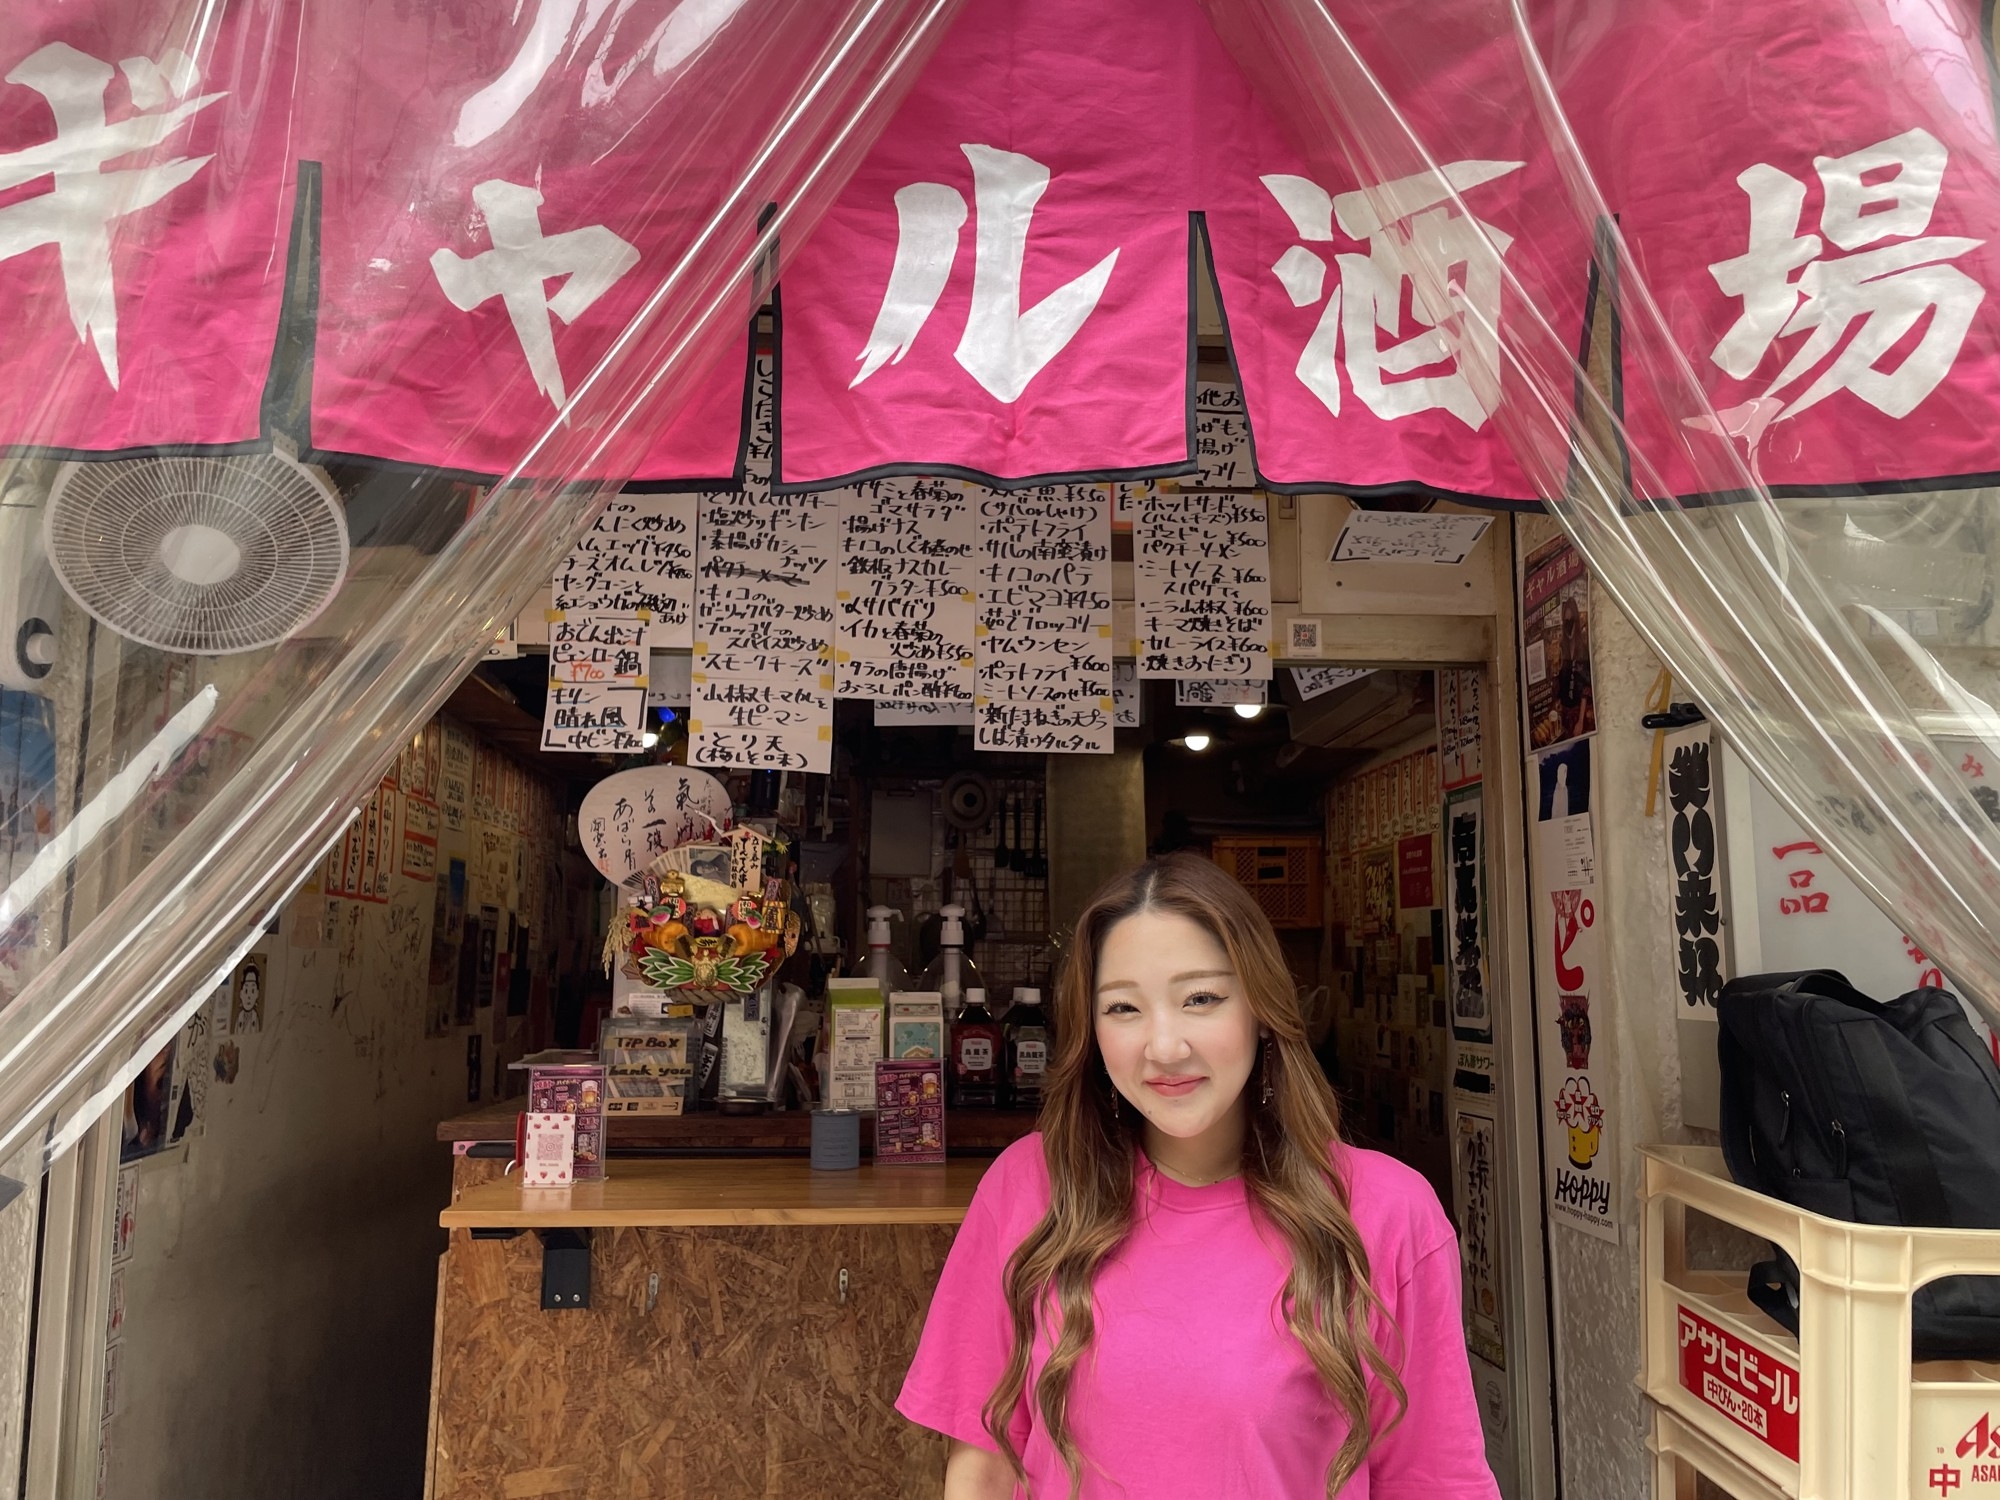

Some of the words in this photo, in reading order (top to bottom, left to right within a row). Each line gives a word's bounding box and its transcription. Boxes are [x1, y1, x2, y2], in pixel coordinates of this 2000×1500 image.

[870, 497, 966, 522] ゴマサラダ
[1144, 495, 1235, 512] ホットサンド
[846, 515, 920, 535] 揚げナス
[988, 515, 1087, 541] ポテトフライ
[1144, 524, 1218, 541] ゴマドレ
[1226, 530, 1267, 547] ¥500
[985, 562, 1093, 587] キノコのパテ
[1144, 559, 1226, 578] ミートソース
[705, 583, 768, 601] キノコの
[1162, 577, 1240, 599] スパゲティ
[987, 635, 1090, 654] ヤムウンセン
[705, 652, 829, 676] スモークチーズ
[981, 660, 1070, 682] ポテトフライ
[1069, 654, 1110, 672] ¥600
[551, 688, 601, 706] キリン
[553, 706, 627, 729] 晴れ風
[728, 703, 809, 727] 生ピーマン
[712, 732, 786, 753] とり天
[658, 1067, 692, 1077] you
[1554, 1202, 1613, 1230] www.hoppy-happy.com
[1679, 1312, 1798, 1415] アサヒビール
[1929, 1463, 1961, 1498] 中
